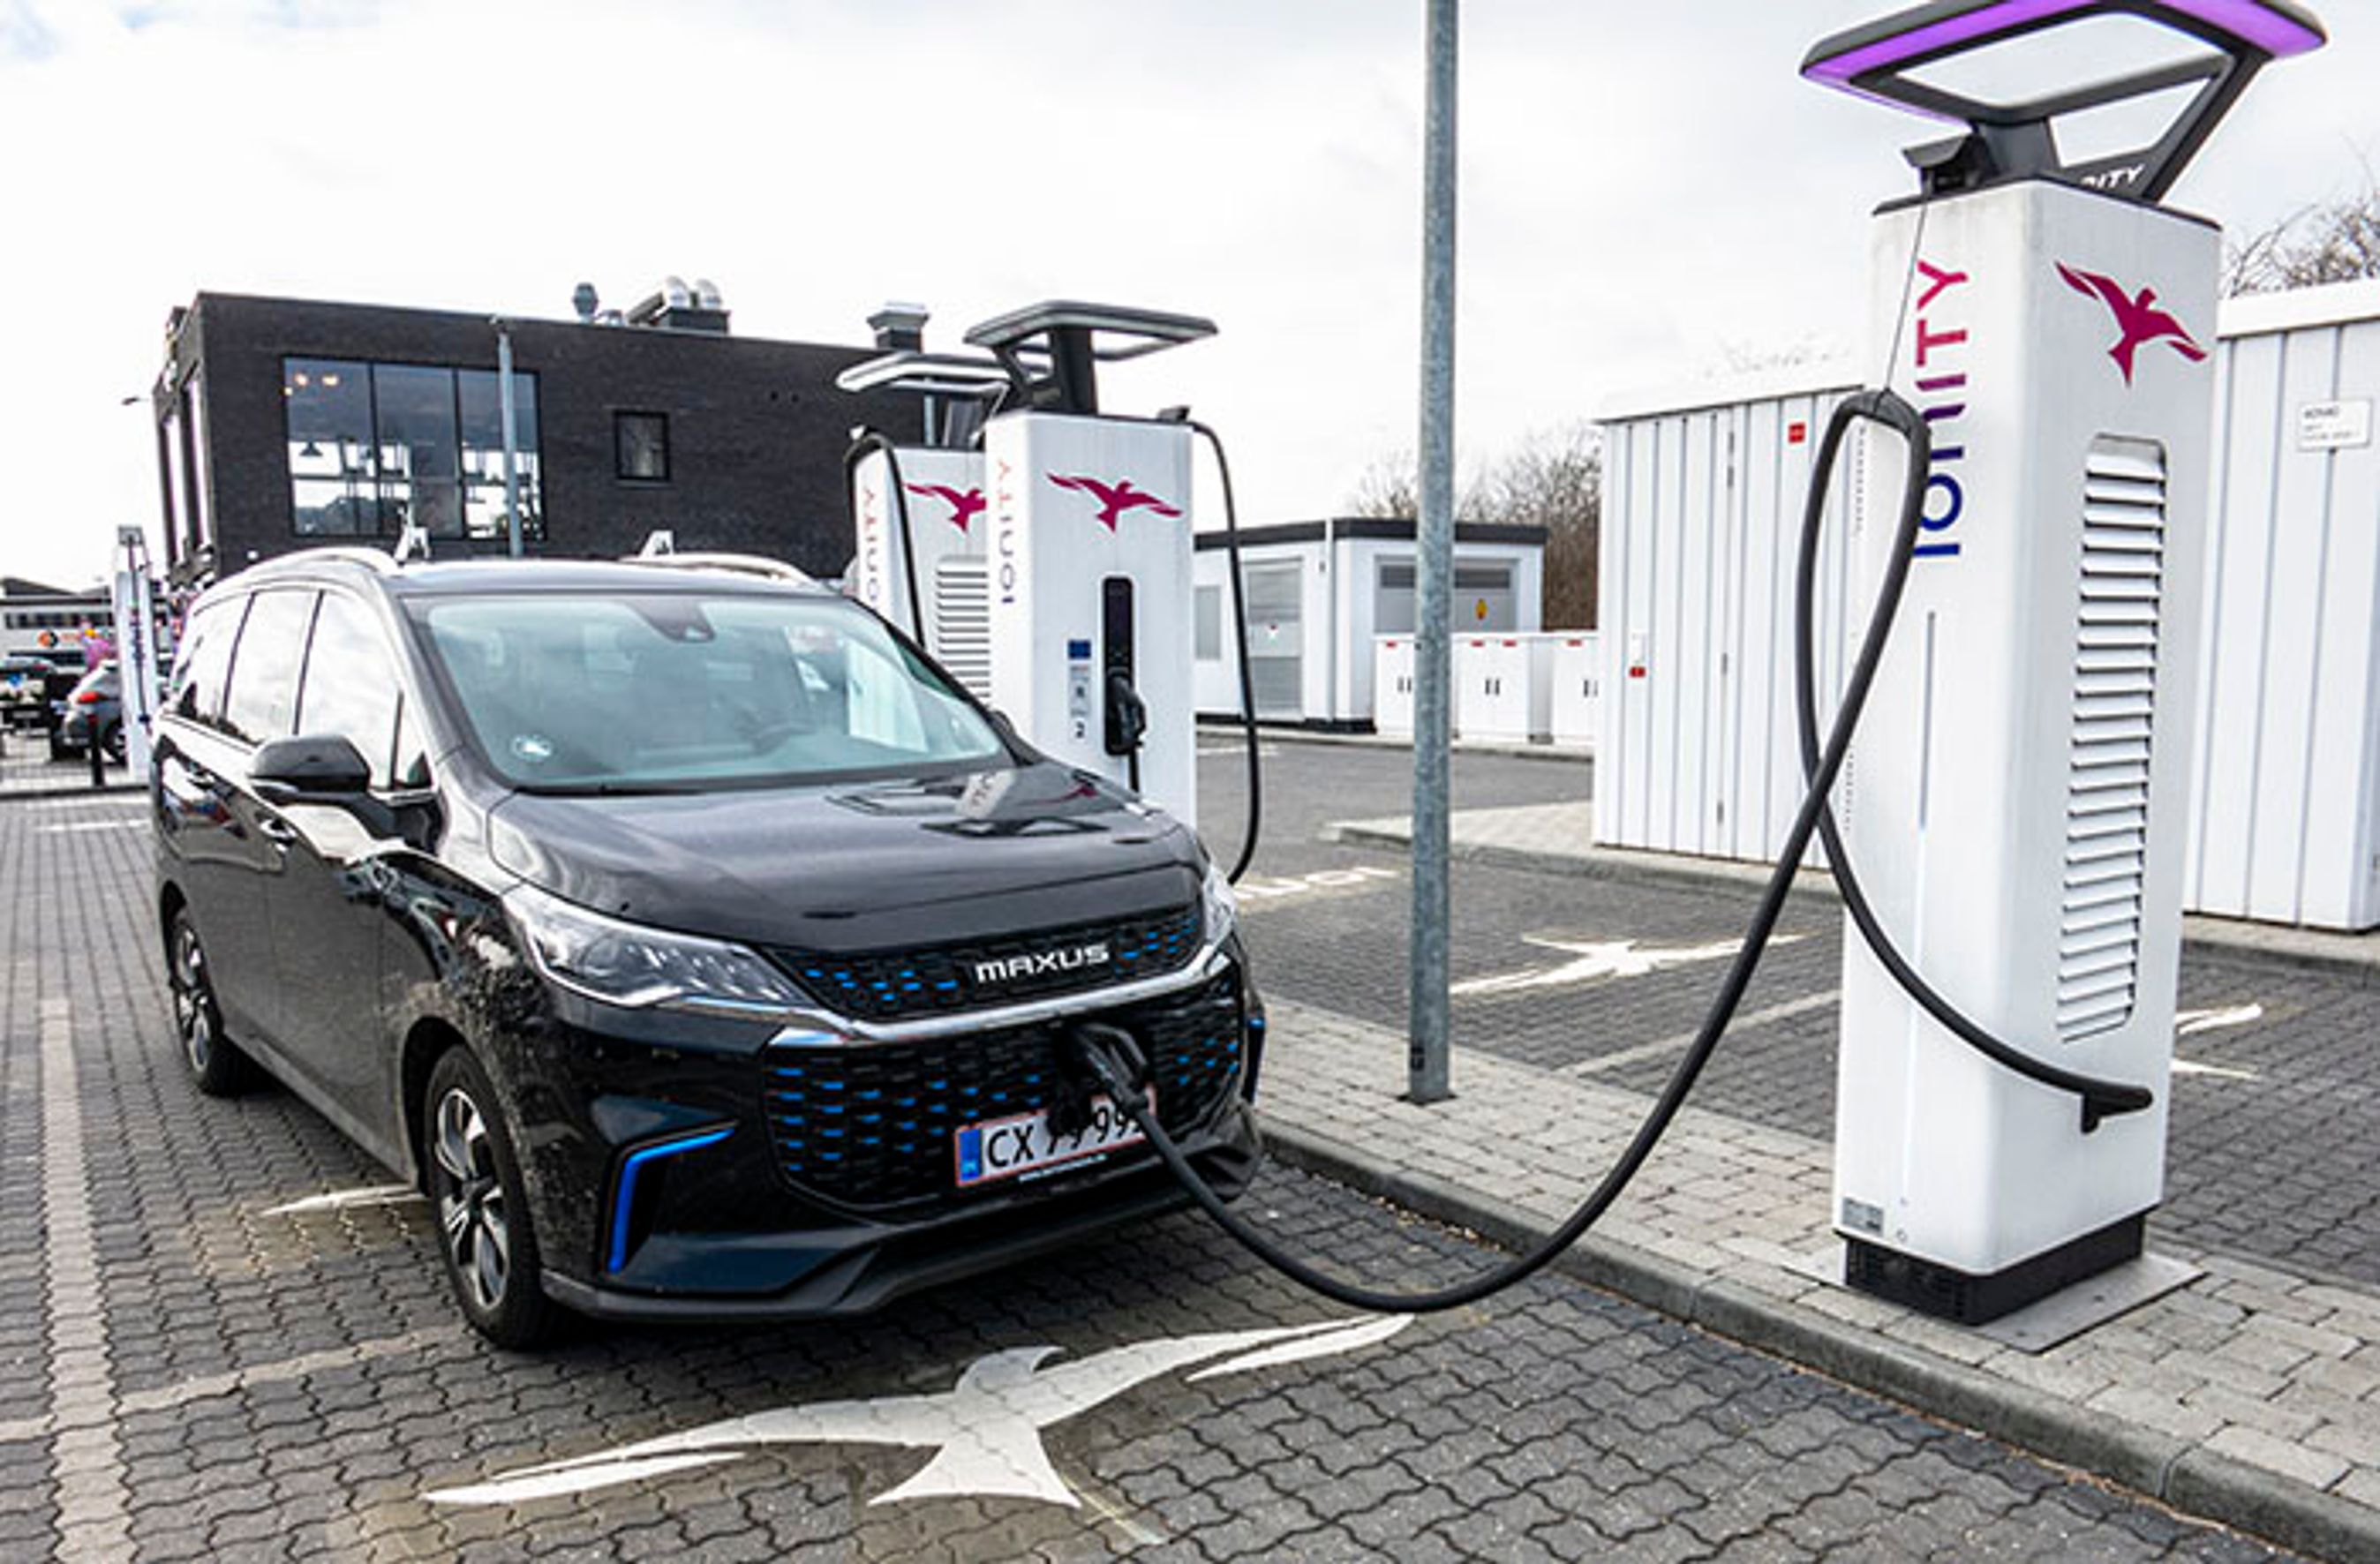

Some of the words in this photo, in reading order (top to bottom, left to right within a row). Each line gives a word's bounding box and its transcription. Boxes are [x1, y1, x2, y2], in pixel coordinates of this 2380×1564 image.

[1915, 259, 1969, 558] IONITY
[863, 487, 880, 602] ONITY
[998, 459, 1016, 604] IONITY
[975, 943, 1110, 983] MAXUS
[987, 1124, 1036, 1168] CX
